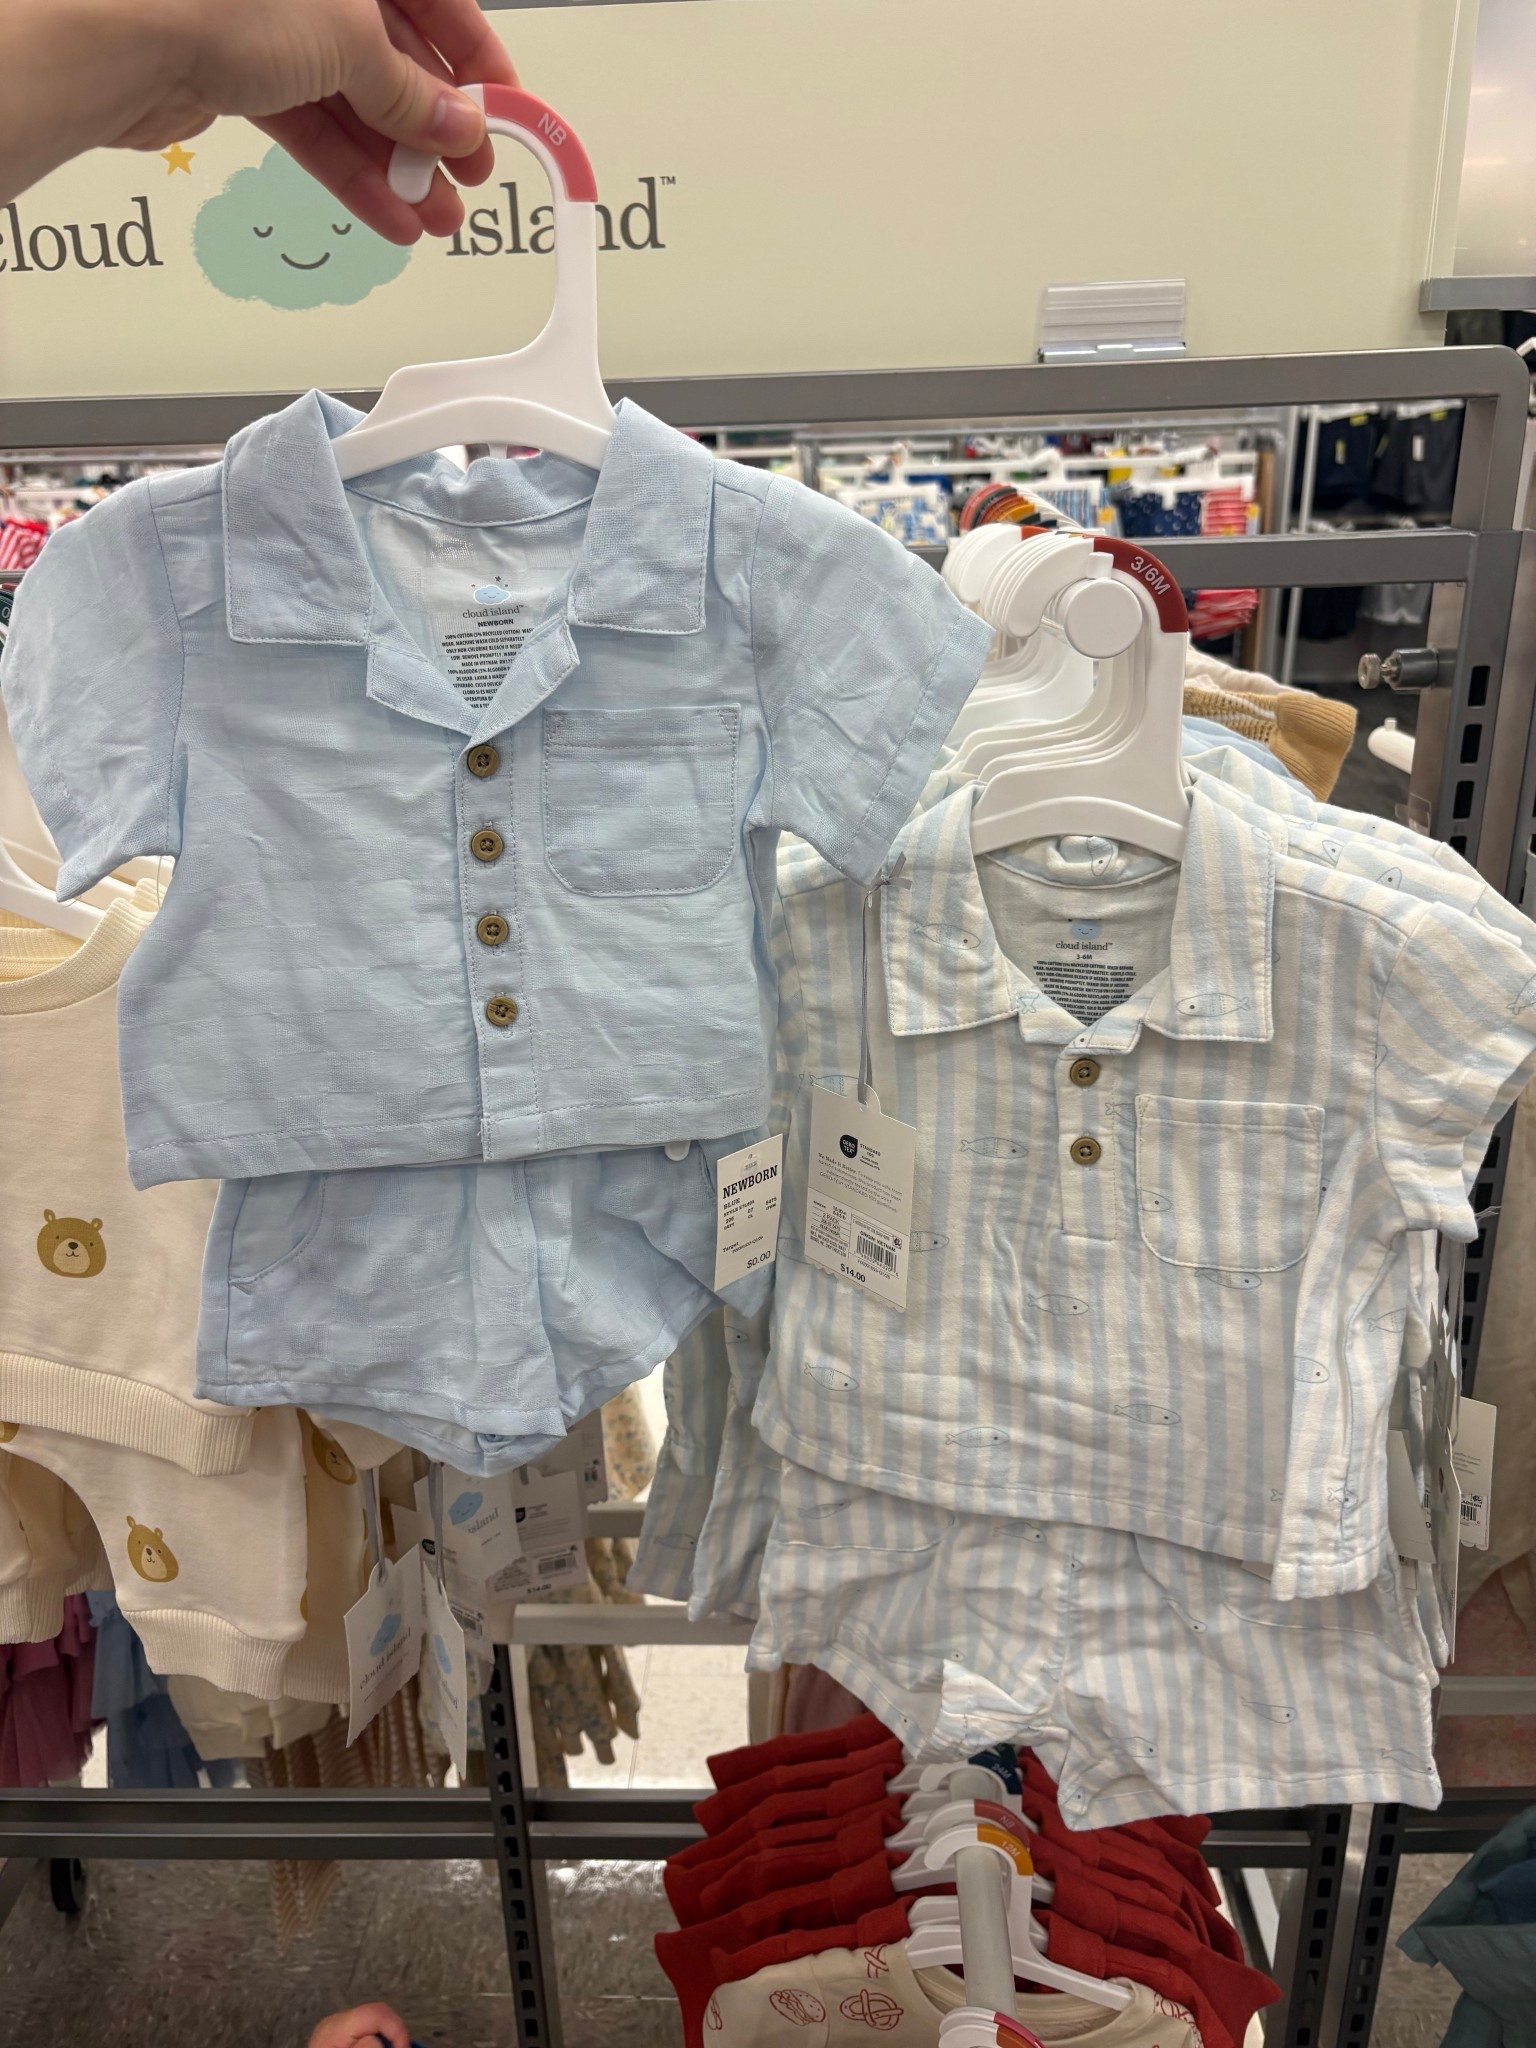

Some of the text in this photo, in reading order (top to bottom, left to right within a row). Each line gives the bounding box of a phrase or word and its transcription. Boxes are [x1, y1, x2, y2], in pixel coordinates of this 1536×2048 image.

[537, 112, 567, 146] NB
[1130, 556, 1170, 595] 3/6M
[463, 609, 488, 618] cloud
[478, 618, 514, 627] NEWBORN
[1056, 941, 1080, 950] cloud
[722, 1164, 777, 1199] NEWBORN
[876, 1238, 895, 1253] VIETNAM
[746, 1249, 771, 1270] $0.00
[840, 1262, 865, 1283] $14.00
[1002, 1840, 1021, 1857] 12M
